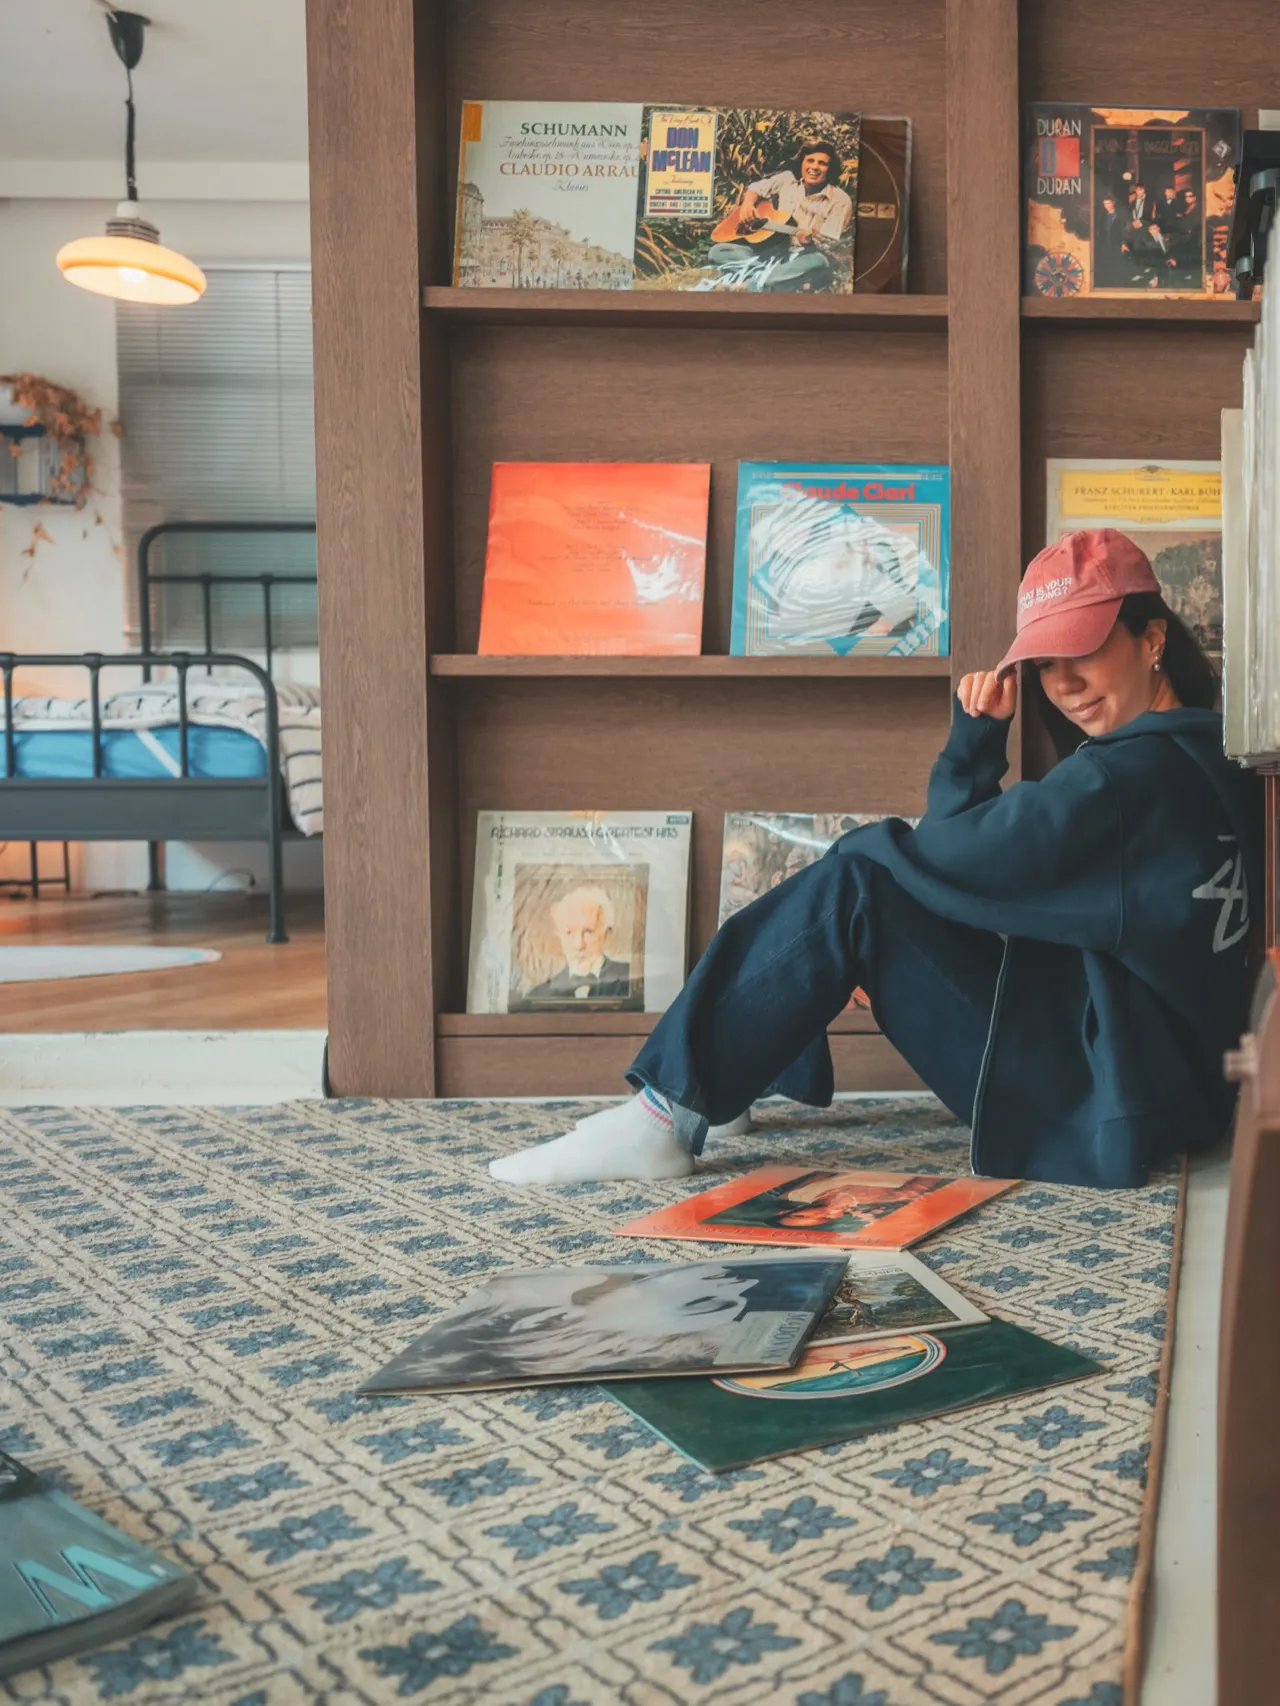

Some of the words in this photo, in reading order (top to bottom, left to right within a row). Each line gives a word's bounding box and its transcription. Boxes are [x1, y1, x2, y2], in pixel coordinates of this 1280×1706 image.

[520, 122, 628, 137] SCHUMANN
[1037, 118, 1082, 136] DURAN
[667, 127, 699, 149] DON
[499, 162, 579, 176] CLAUDIO
[1037, 177, 1082, 195] DURAN
[1075, 487, 1108, 495] FRANZ
[1111, 487, 1165, 495] SCHUBERT
[1171, 487, 1195, 496] KARL
[1045, 576, 1072, 592] YOUR
[490, 826, 542, 840] RICHARD
[656, 826, 678, 840] HITS
